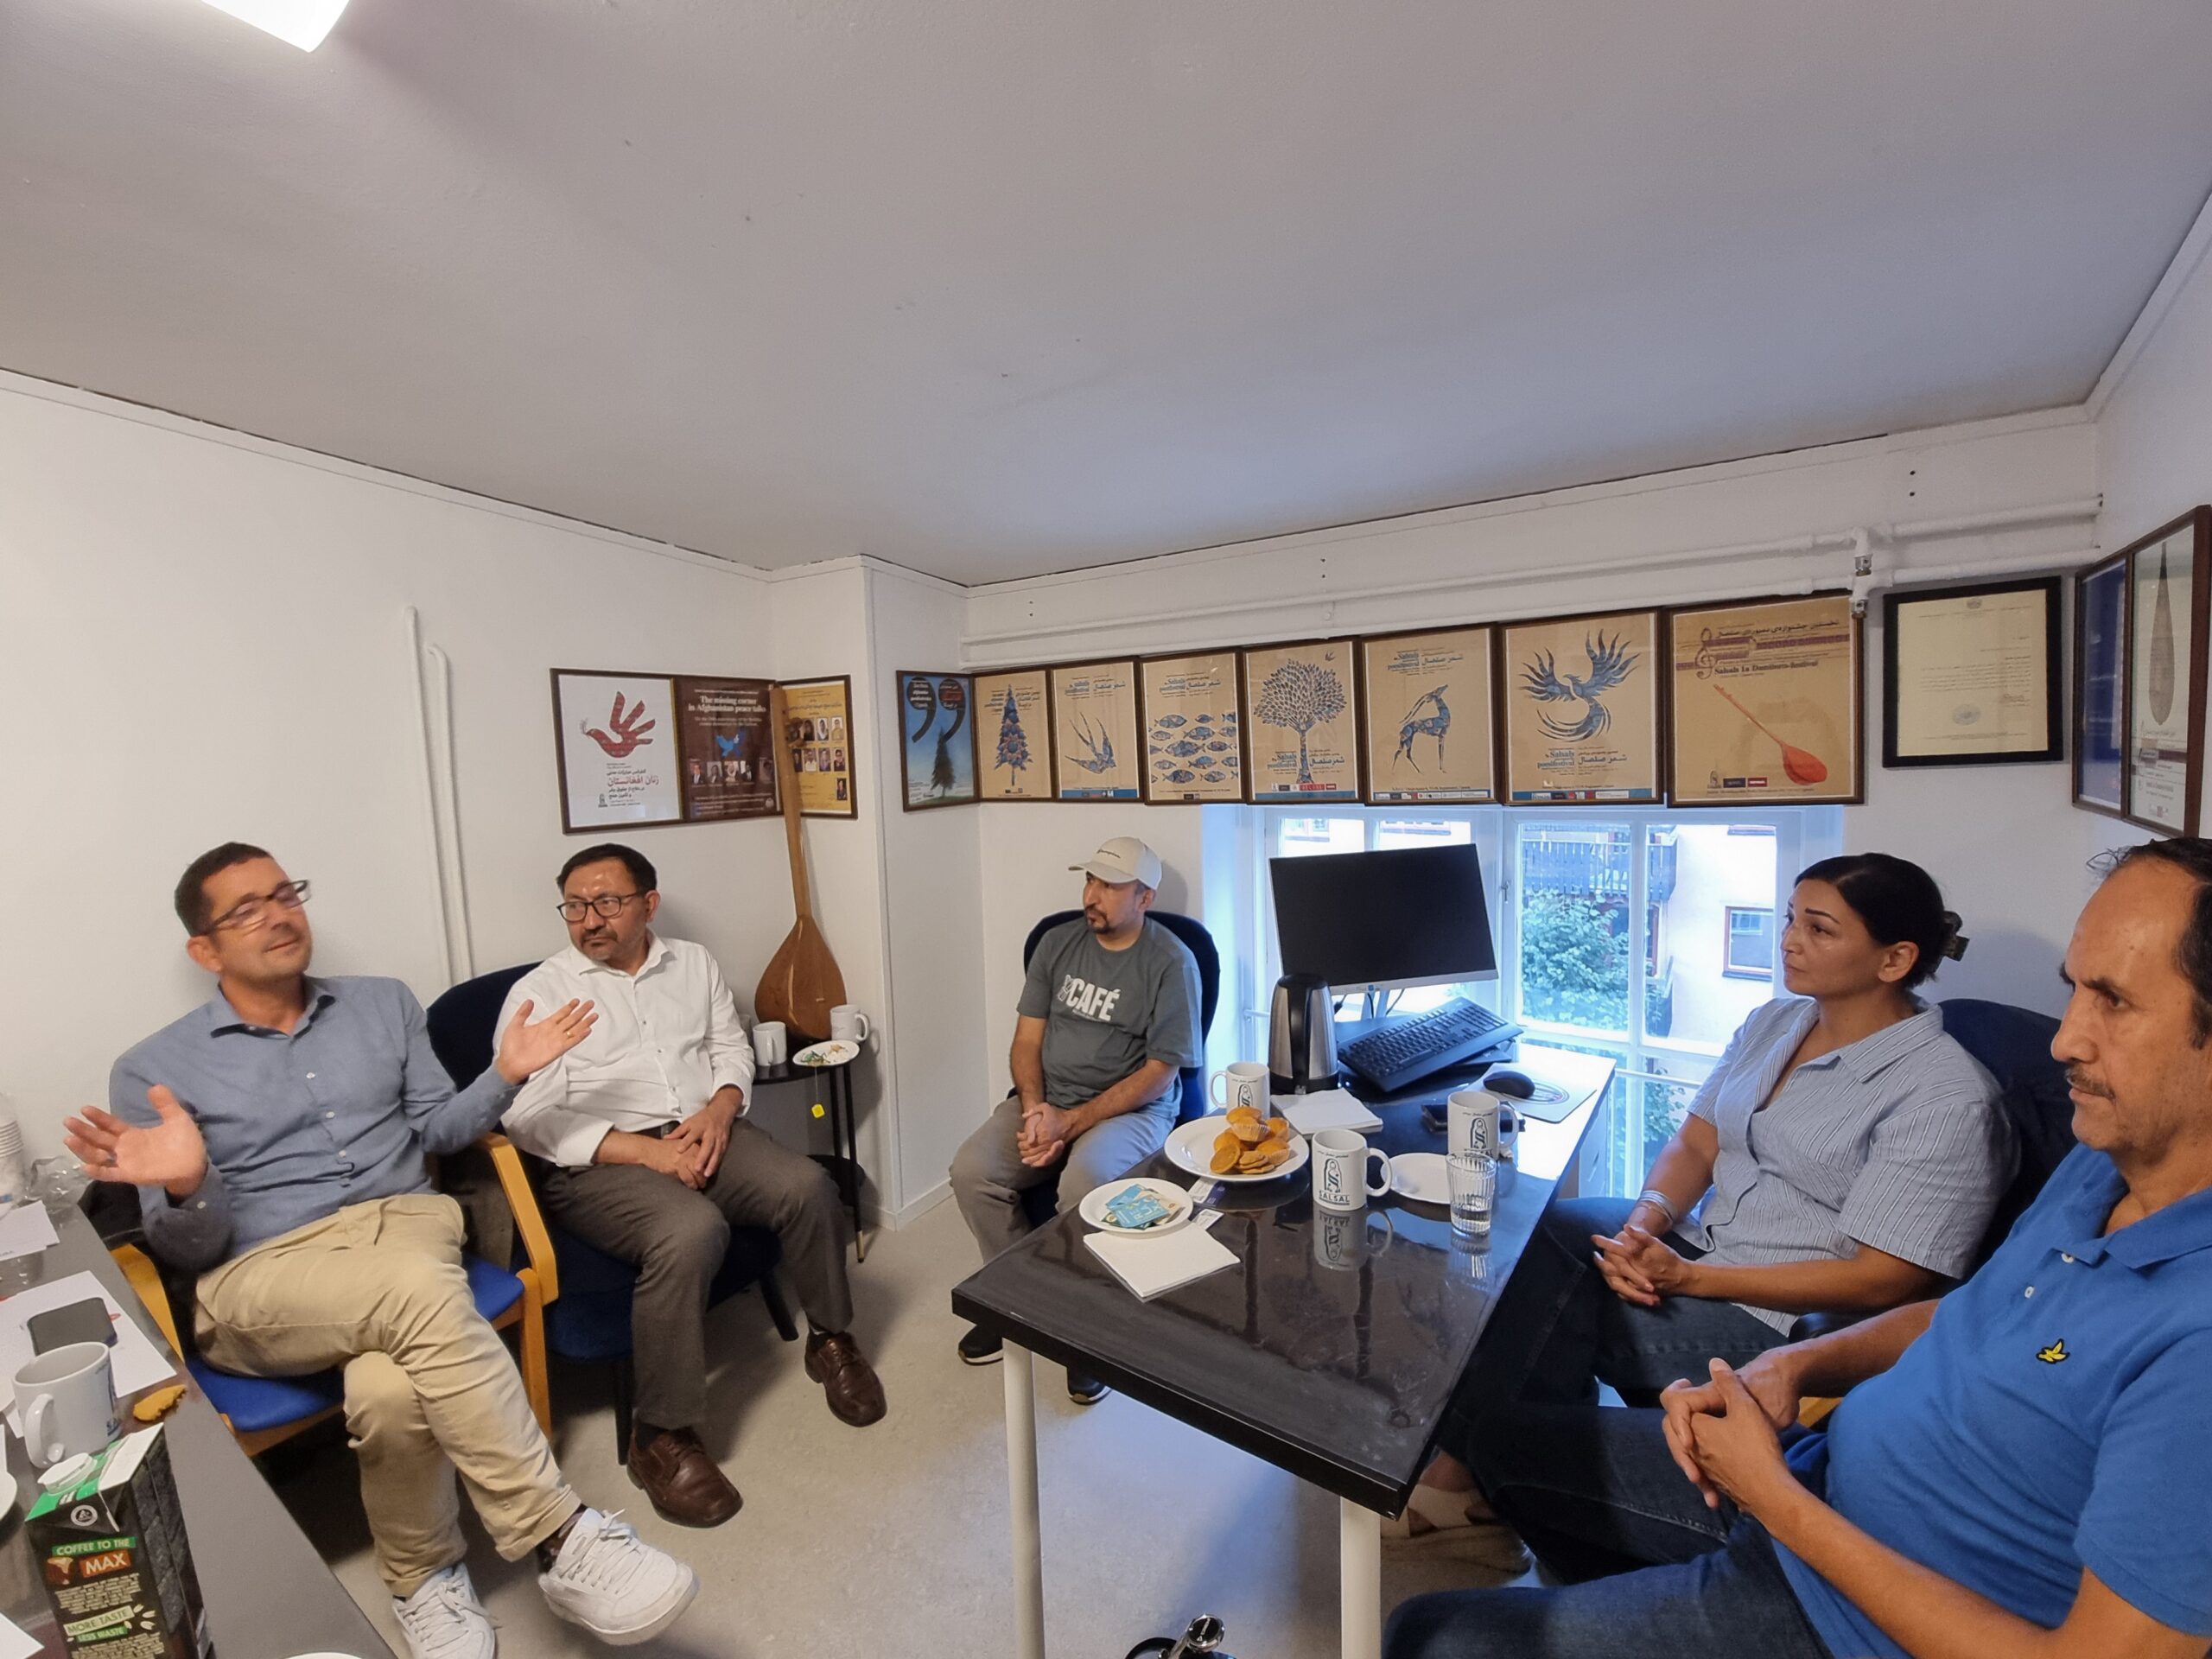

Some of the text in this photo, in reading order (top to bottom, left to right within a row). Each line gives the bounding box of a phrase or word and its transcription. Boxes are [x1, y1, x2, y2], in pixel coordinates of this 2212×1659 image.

[1066, 978, 1121, 1021] CAFÉ
[1319, 1190, 1350, 1203] SALSAL
[57, 1538, 130, 1555] COFFEE TO THE
[86, 1553, 128, 1575] MAX
[67, 1609, 128, 1634] MORE TASTE
